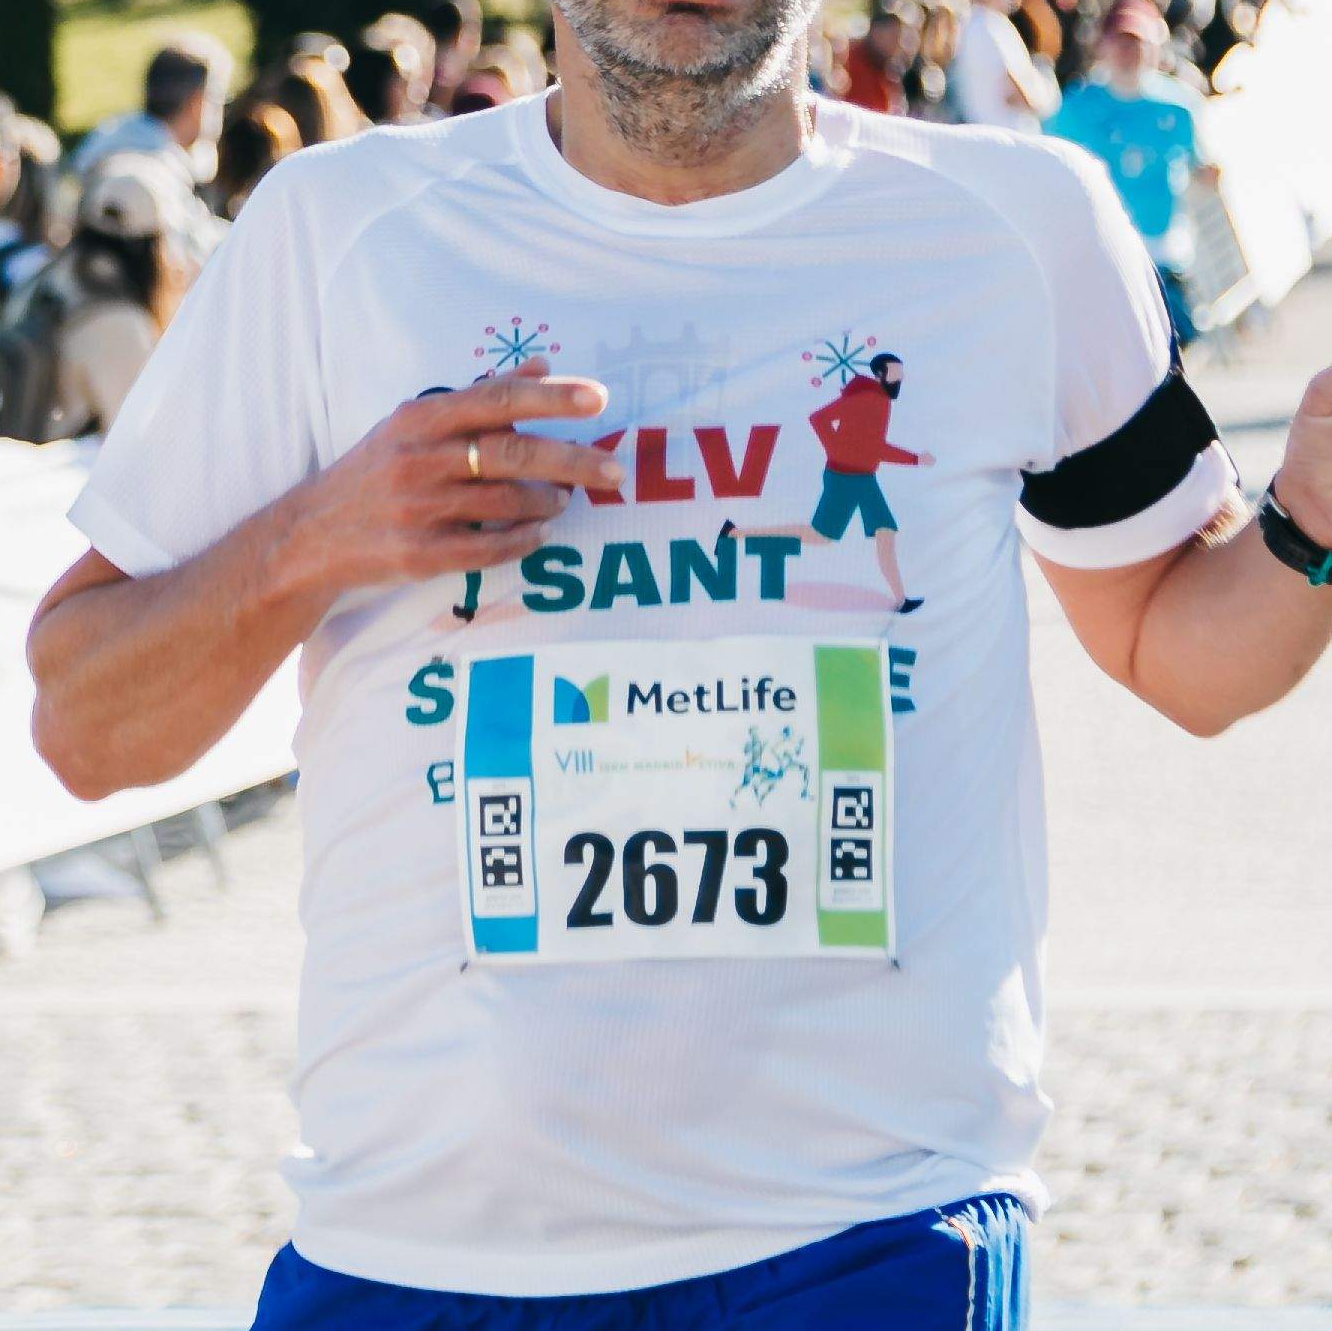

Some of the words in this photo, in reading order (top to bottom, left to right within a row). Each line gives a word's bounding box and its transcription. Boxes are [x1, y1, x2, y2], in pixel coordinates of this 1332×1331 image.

[520, 535, 801, 613] SANT
[626, 678, 797, 716] MetLife
[563, 826, 790, 931] 2673
